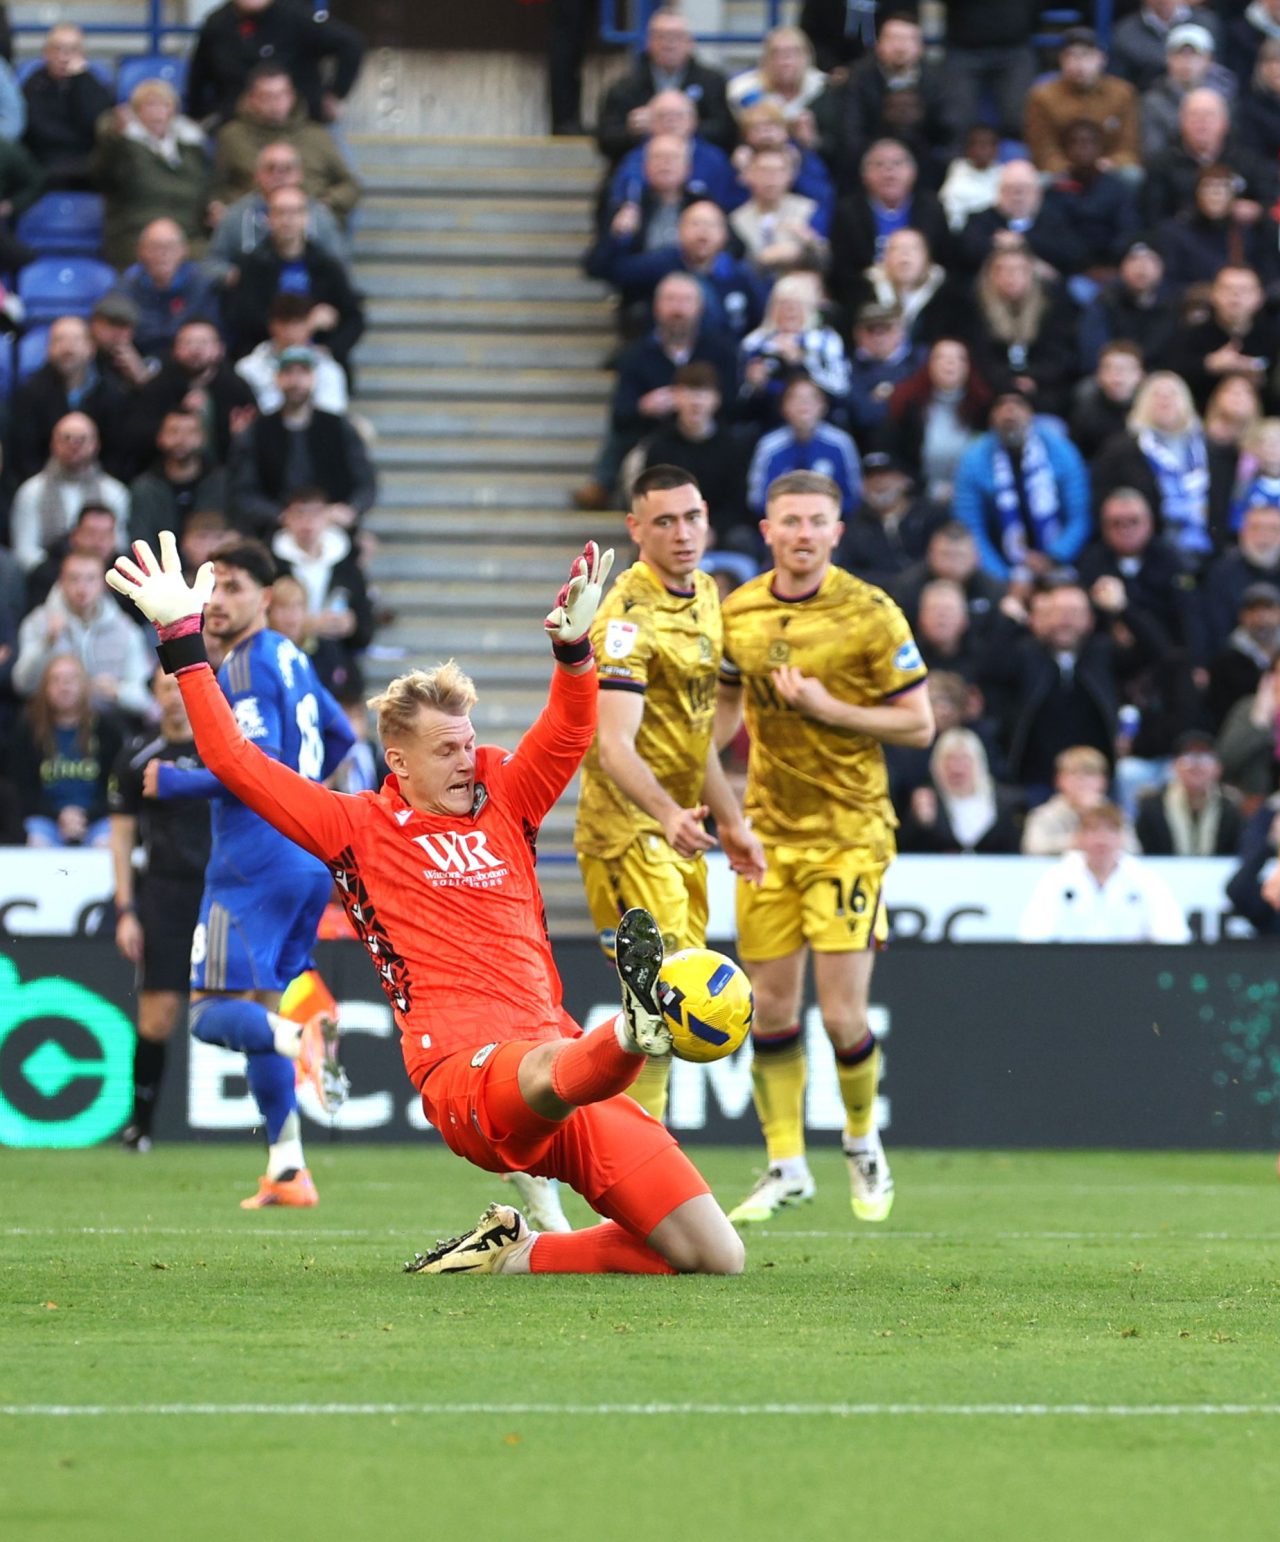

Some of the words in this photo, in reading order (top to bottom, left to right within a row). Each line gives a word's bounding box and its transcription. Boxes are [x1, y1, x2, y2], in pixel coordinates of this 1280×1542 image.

[296, 692, 325, 780] 8
[411, 830, 506, 874] WR
[831, 874, 867, 917] 16
